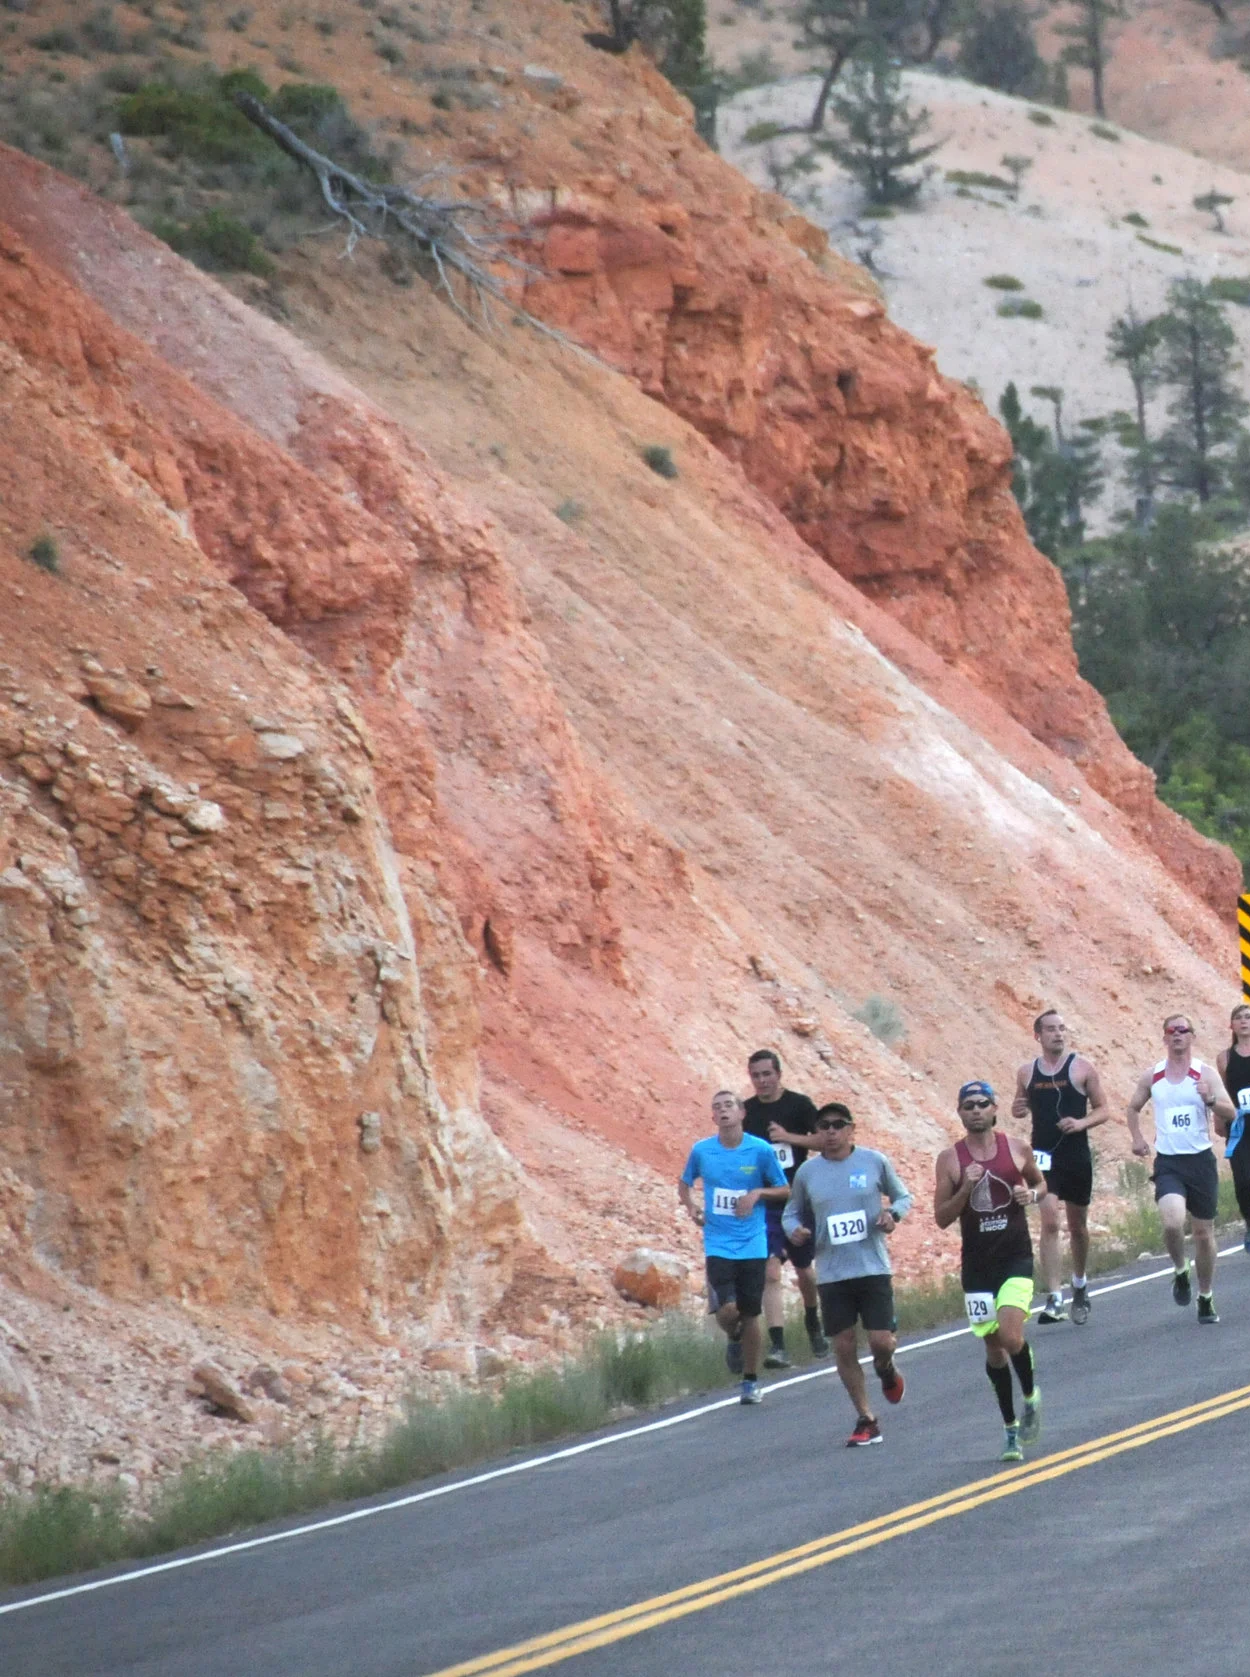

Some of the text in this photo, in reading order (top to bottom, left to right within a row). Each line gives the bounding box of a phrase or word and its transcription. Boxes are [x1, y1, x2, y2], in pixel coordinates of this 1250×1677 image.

[1172, 1114, 1191, 1128] 466
[716, 1195, 738, 1210] 119
[832, 1218, 866, 1239] 1320
[967, 1300, 989, 1316] 129
